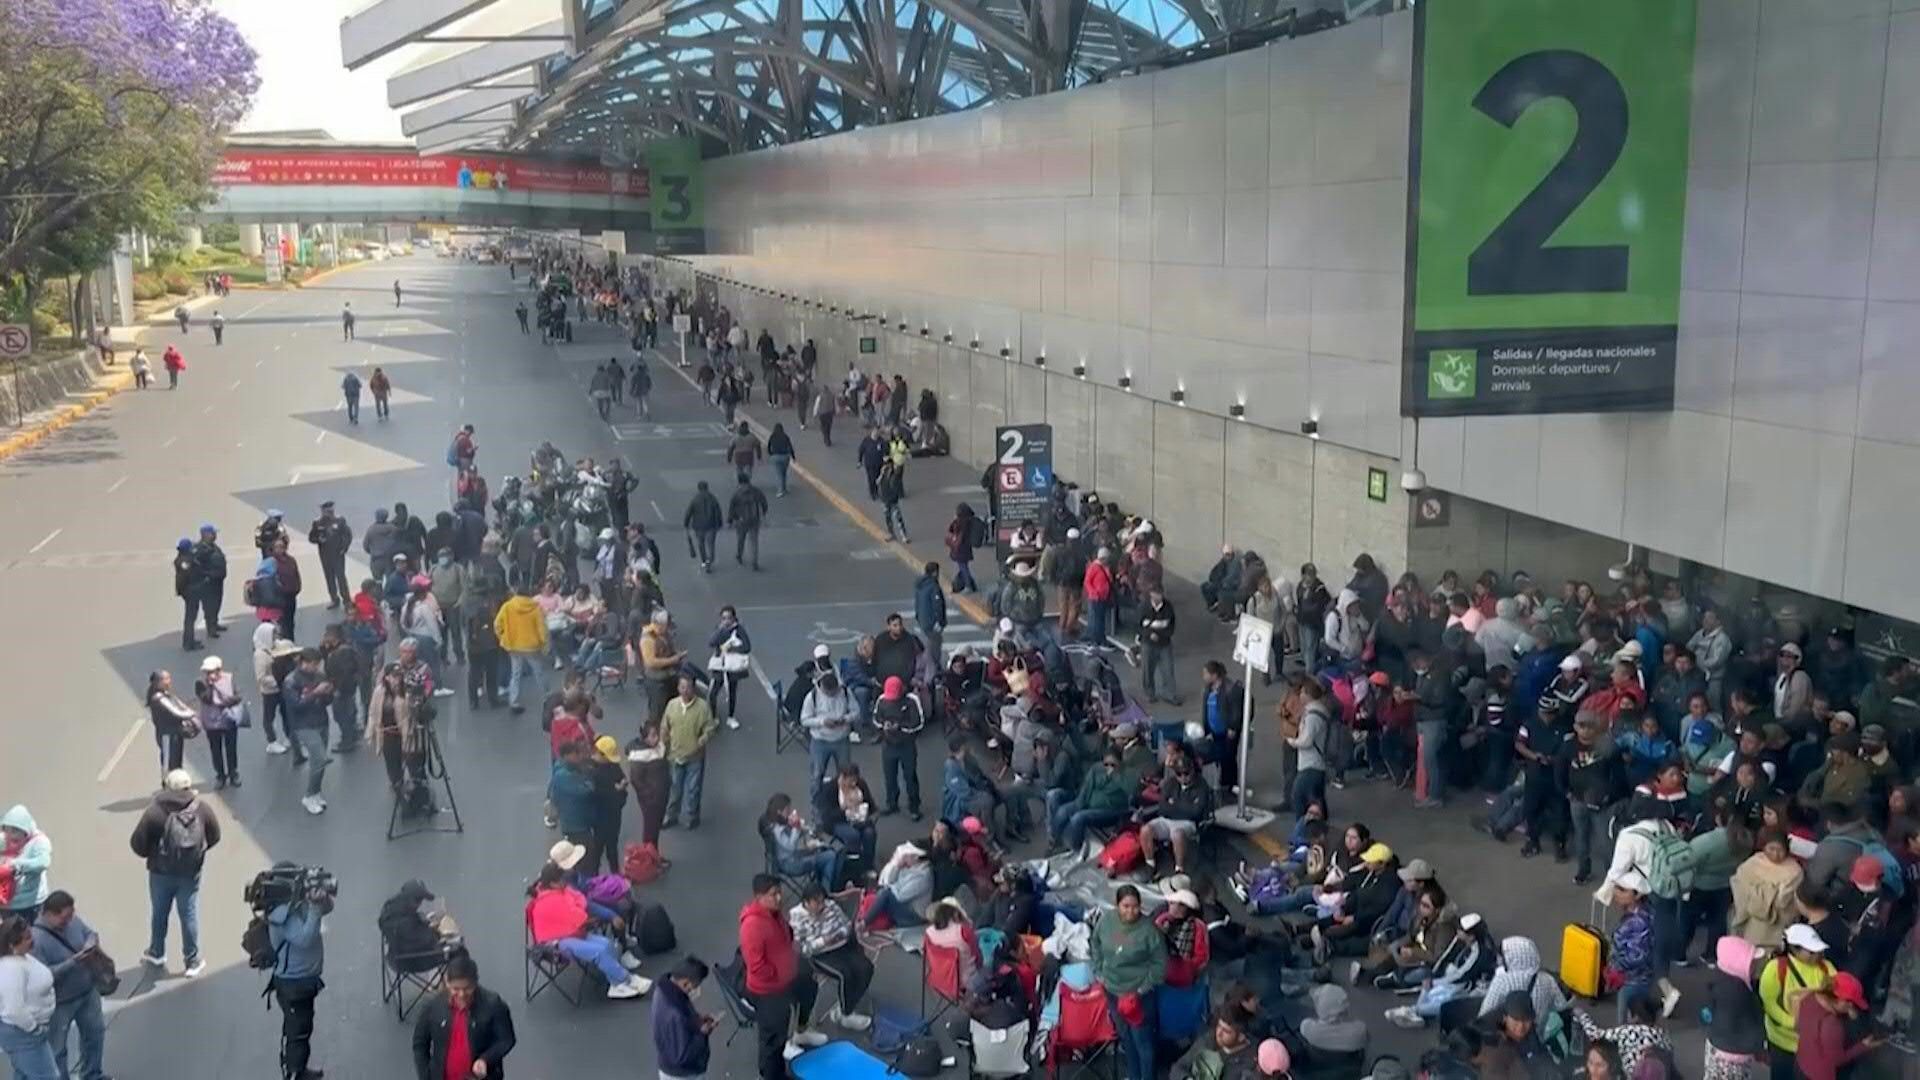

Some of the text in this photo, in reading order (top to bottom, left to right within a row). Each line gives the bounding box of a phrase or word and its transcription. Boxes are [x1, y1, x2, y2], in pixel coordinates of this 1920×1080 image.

[1467, 49, 1630, 296] 2
[660, 176, 691, 222] 3
[1493, 348, 1533, 360] Salidas
[1546, 347, 1594, 360] llegadas
[1596, 345, 1657, 358] nacionales
[1491, 363, 1546, 376] Domestic
[1549, 362, 1611, 377] departures
[1491, 379, 1532, 392] arrivals
[1000, 429, 1024, 465] 2
